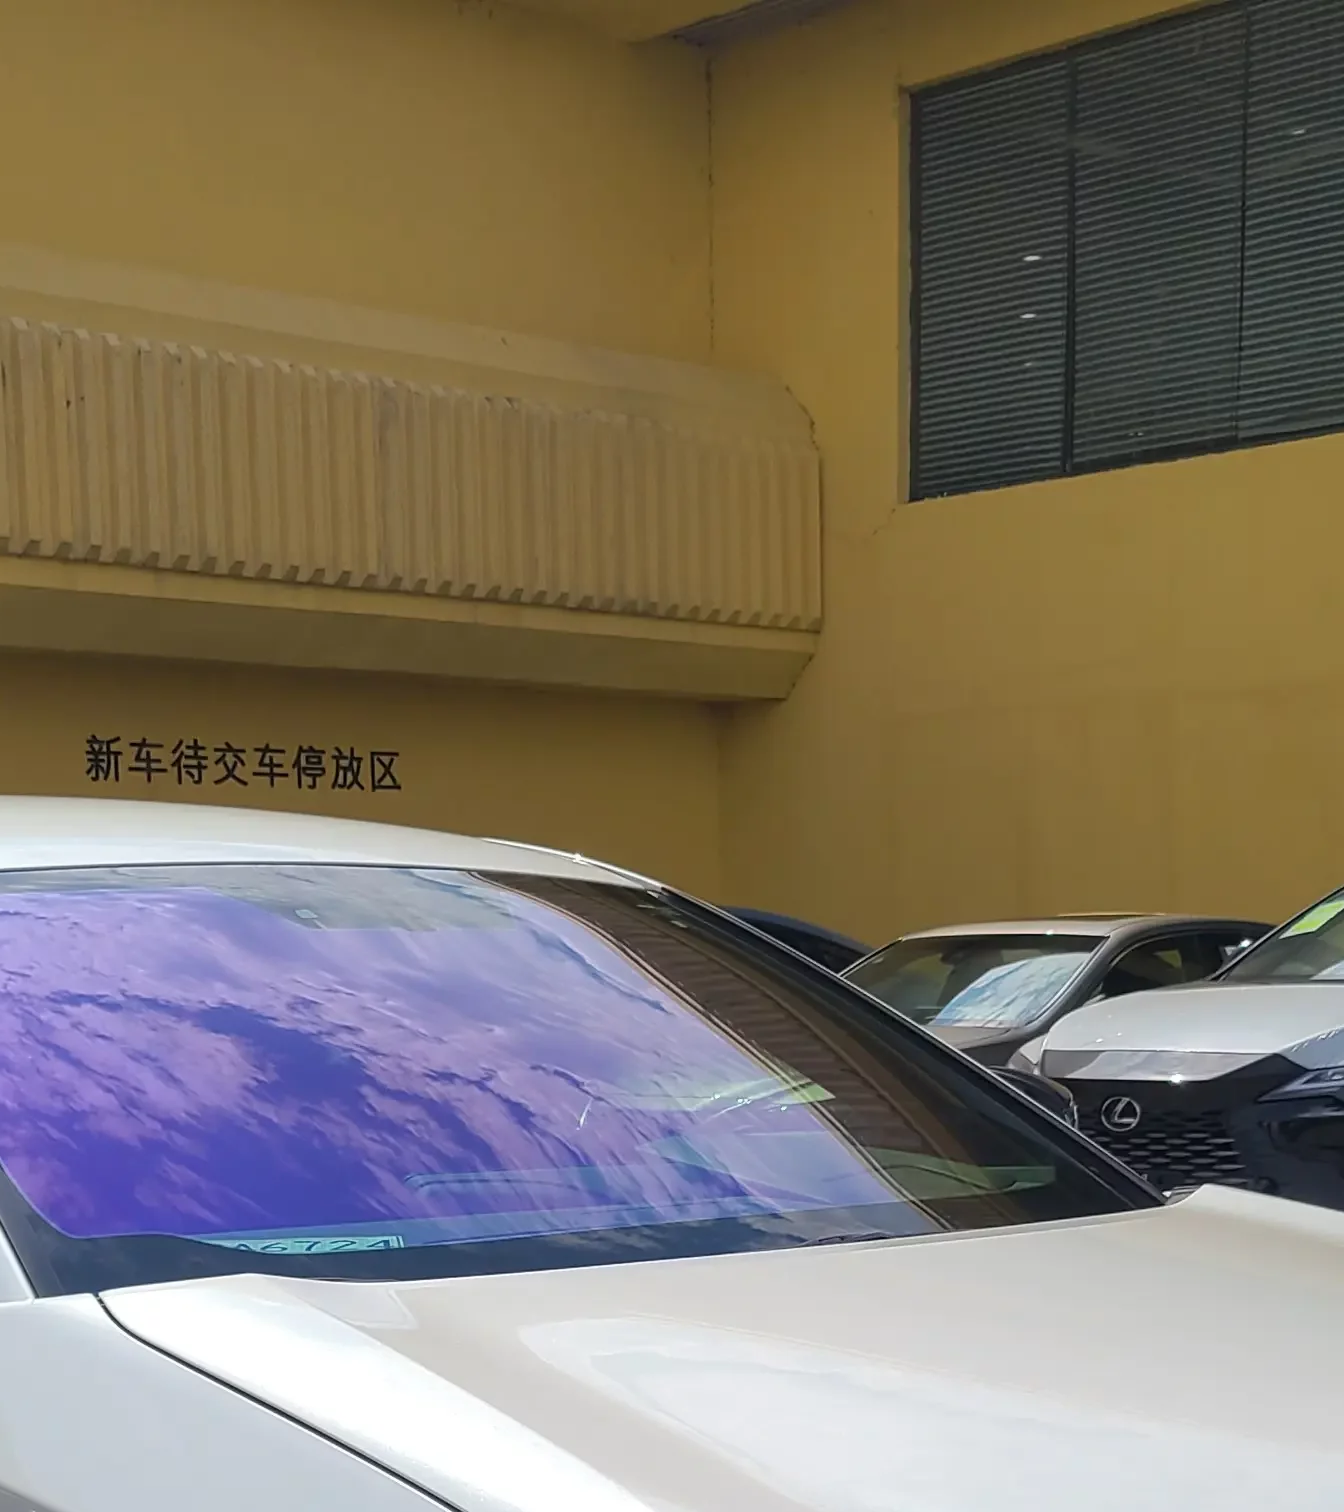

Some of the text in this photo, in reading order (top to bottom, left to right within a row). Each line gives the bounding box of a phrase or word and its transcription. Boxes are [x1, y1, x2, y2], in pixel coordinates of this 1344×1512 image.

[84, 733, 402, 792] 新车待交车停放区
